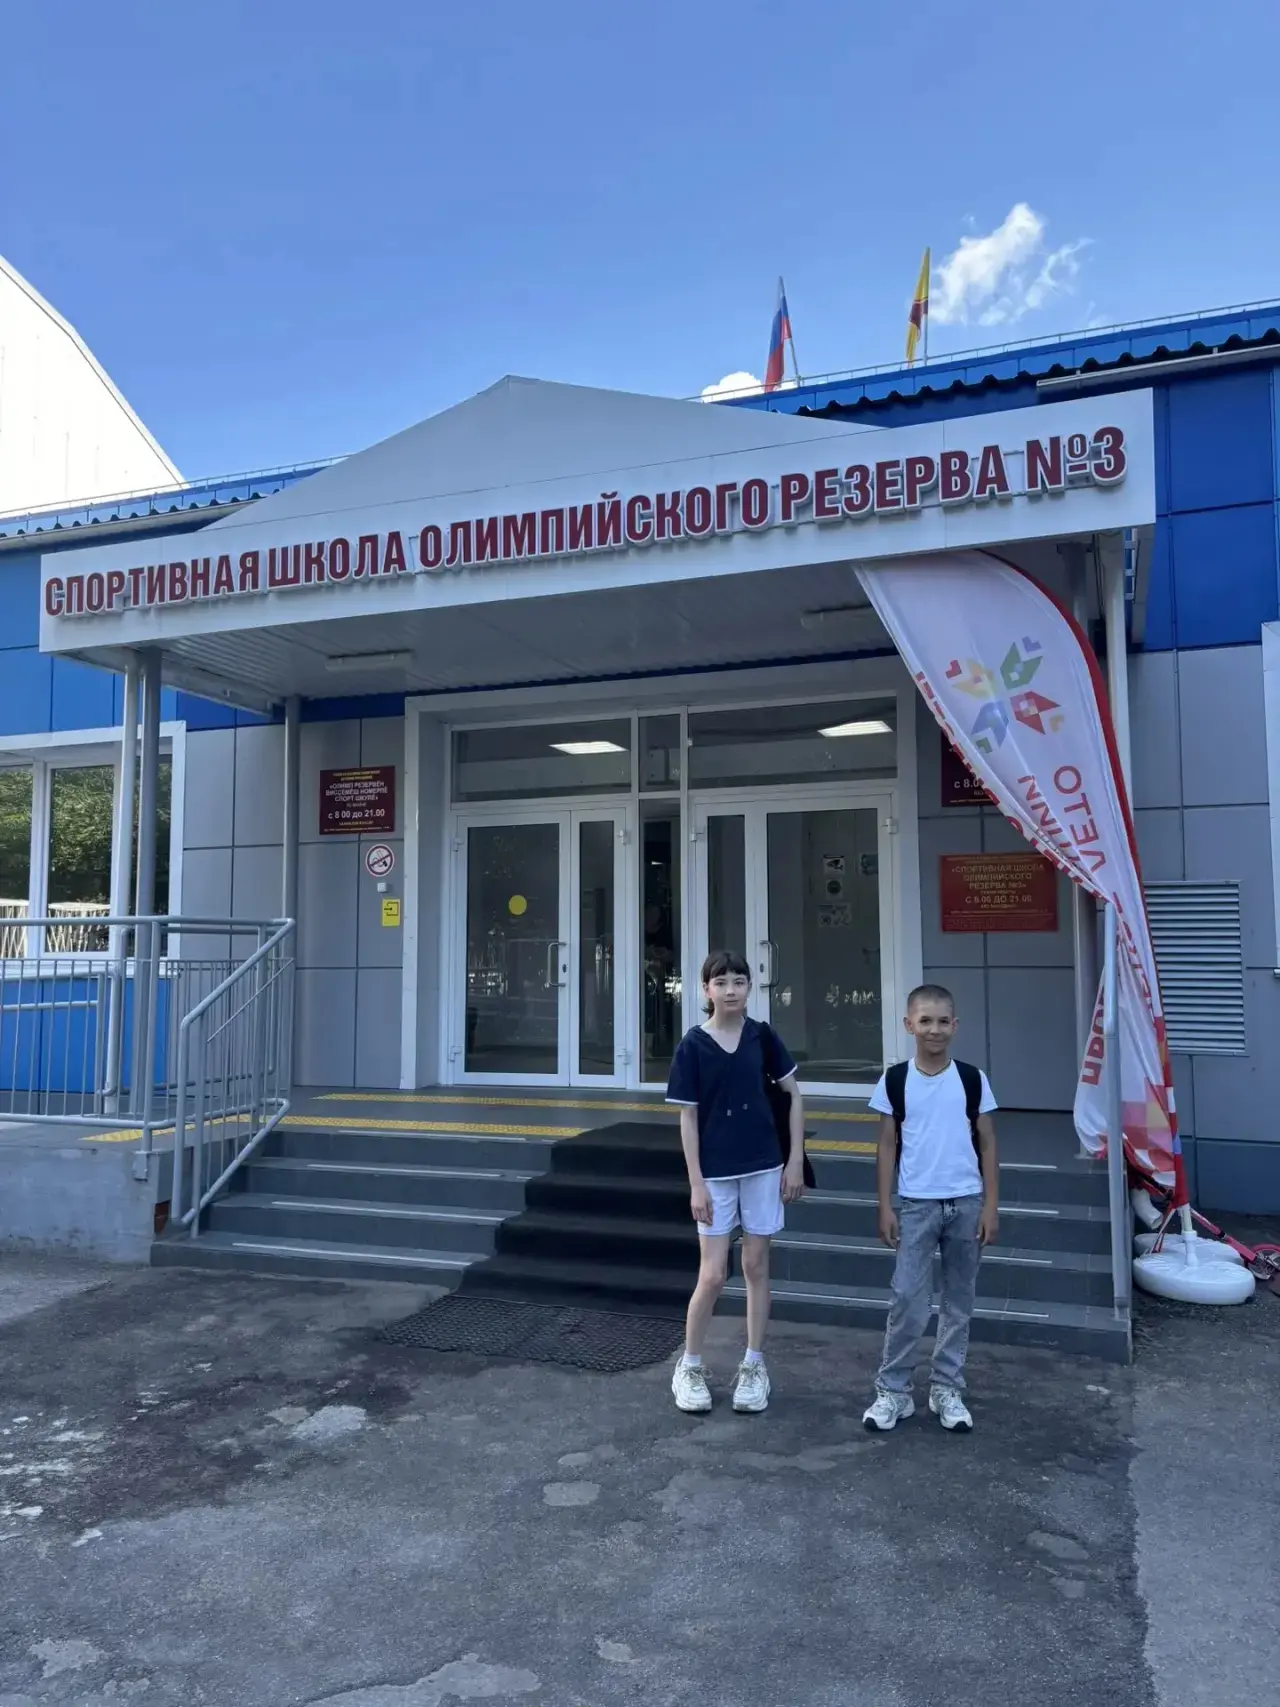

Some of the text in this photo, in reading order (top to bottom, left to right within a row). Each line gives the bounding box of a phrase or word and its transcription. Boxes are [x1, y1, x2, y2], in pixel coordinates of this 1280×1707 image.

[45, 425, 1127, 617] СПОРТИВНАЯ ШКОЛА ОЛИМПИЙСКОГО РЕЗЕРВА №3
[954, 781, 961, 789] с
[352, 811, 363, 819] до
[364, 808, 385, 817] 21.00
[969, 881, 1007, 889] РЕЗЕРВА
[993, 895, 1007, 904] ДО
